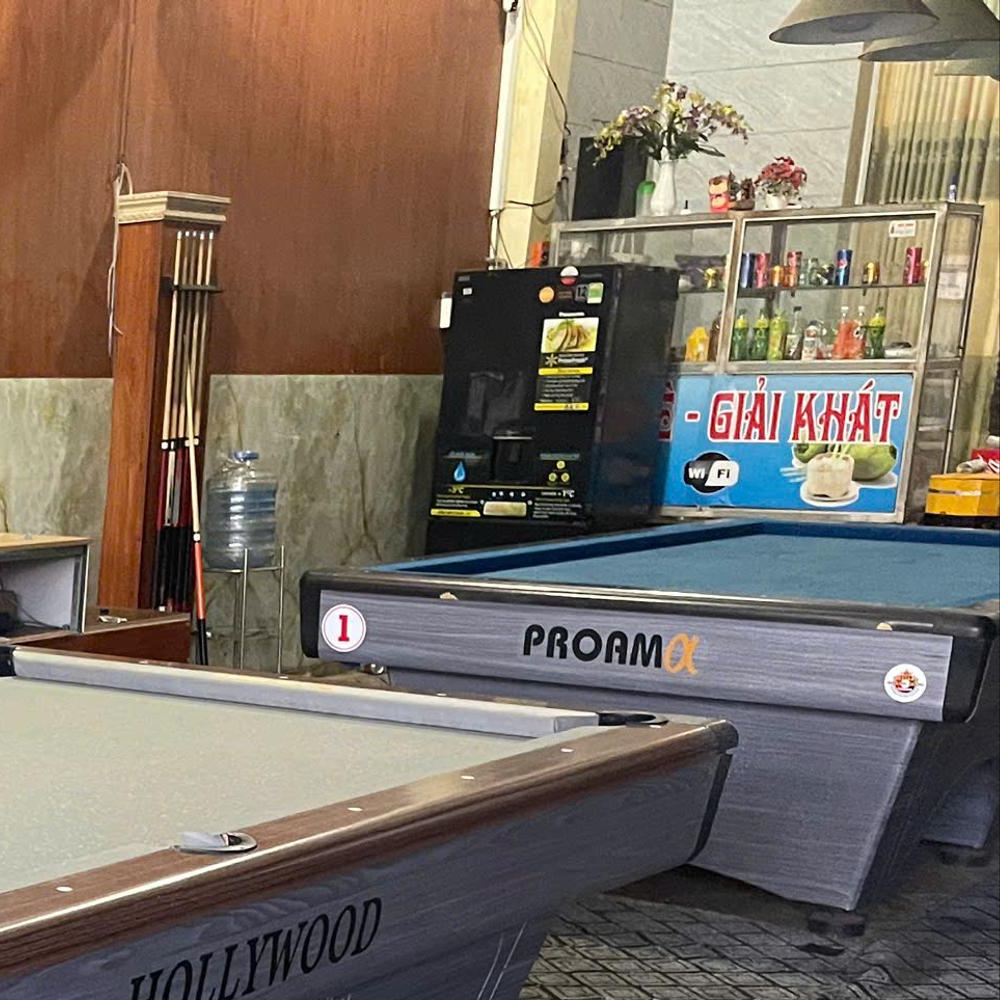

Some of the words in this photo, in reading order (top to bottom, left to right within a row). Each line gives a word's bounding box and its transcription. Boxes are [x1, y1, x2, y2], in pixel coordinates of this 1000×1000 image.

[708, 376, 785, 442] GIẢI
[789, 378, 902, 443] KHÁT
[338, 614, 350, 642] 1
